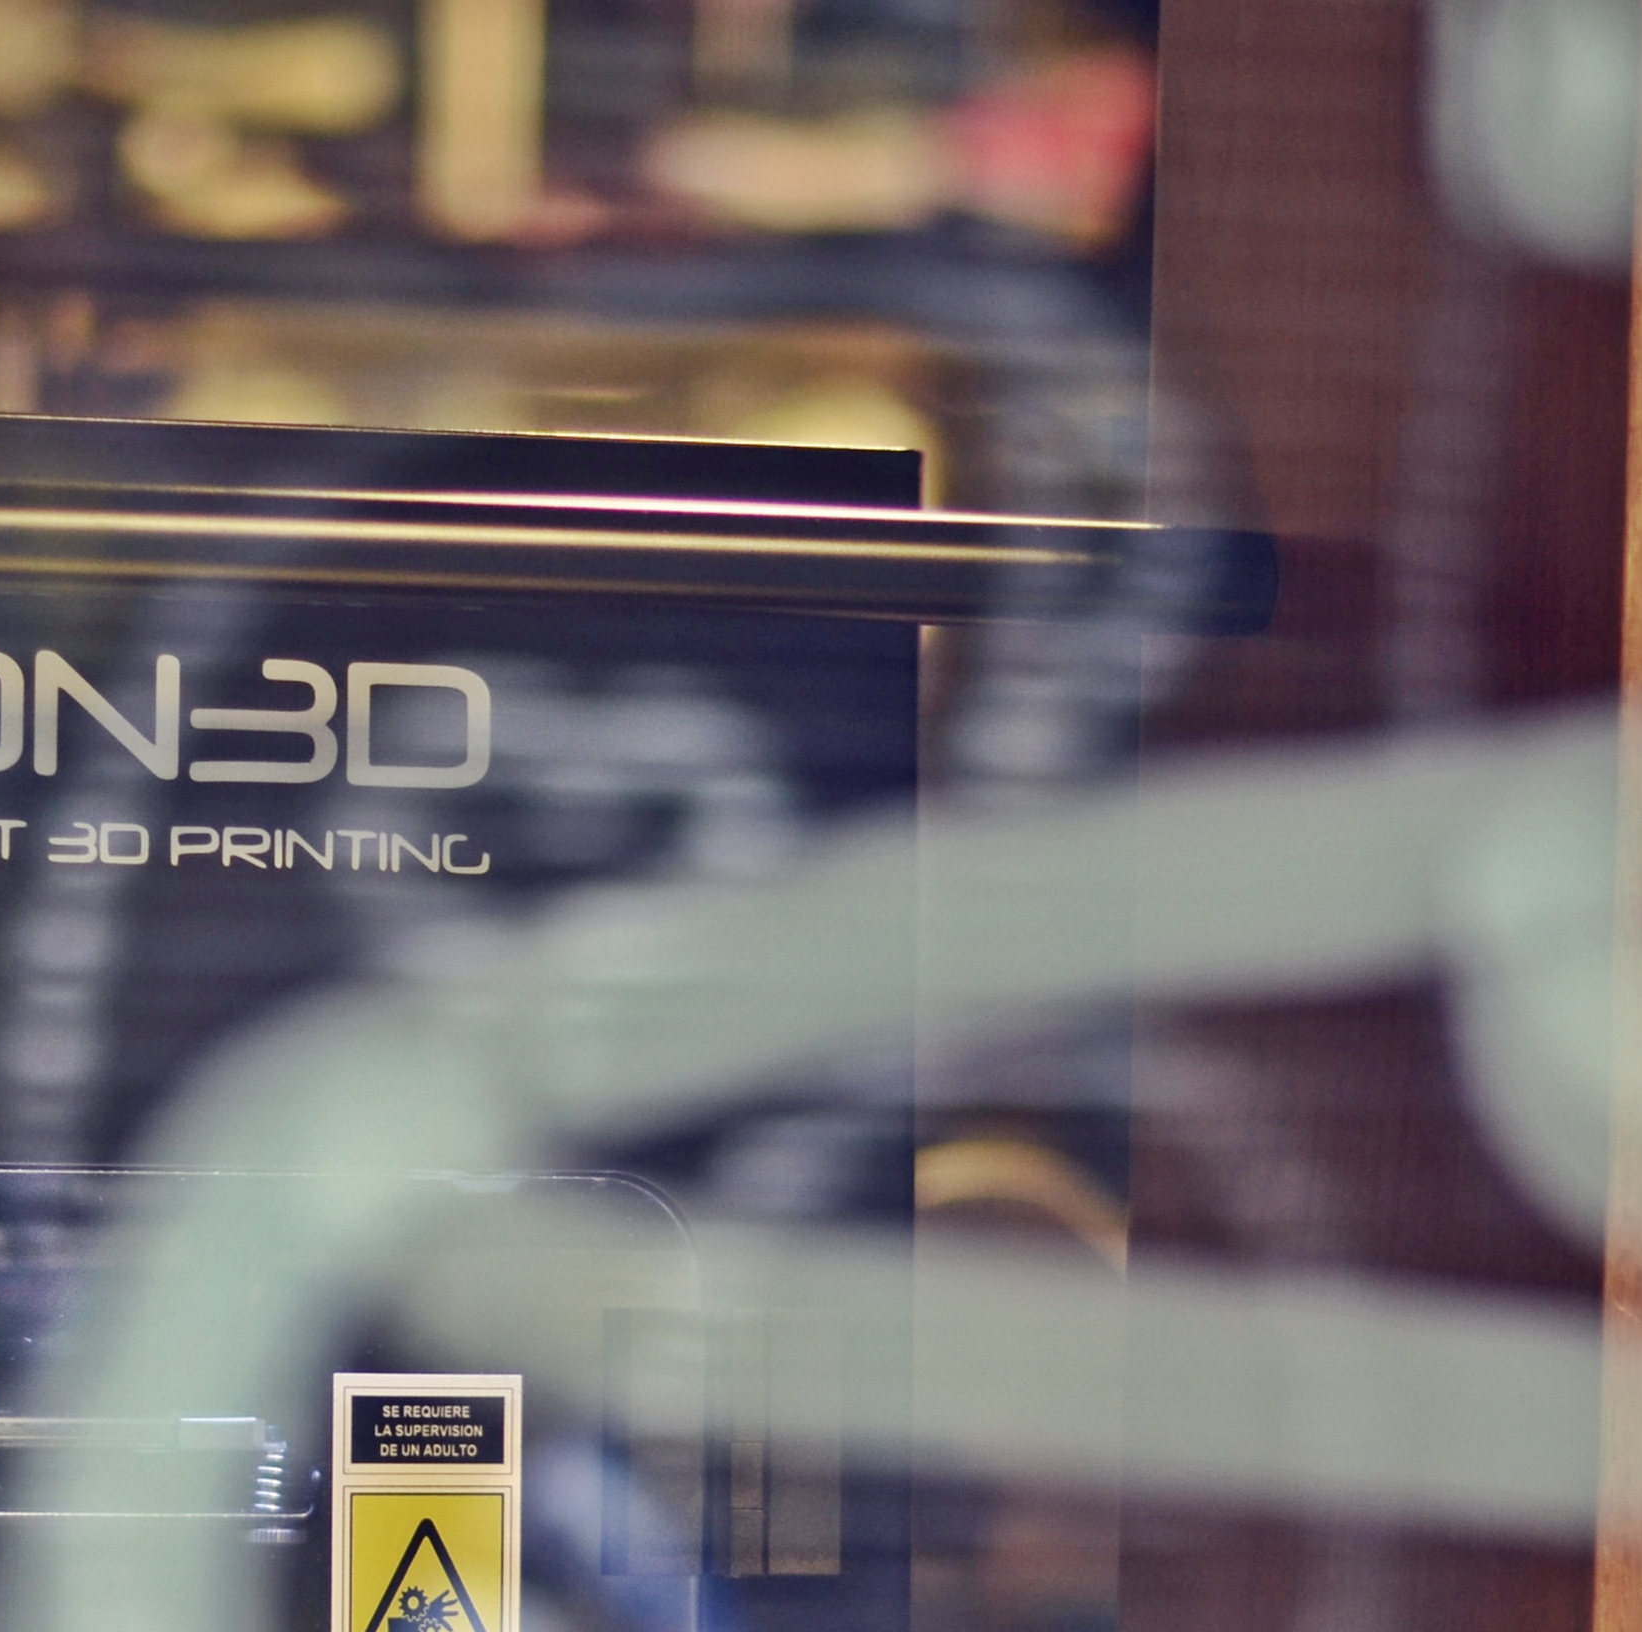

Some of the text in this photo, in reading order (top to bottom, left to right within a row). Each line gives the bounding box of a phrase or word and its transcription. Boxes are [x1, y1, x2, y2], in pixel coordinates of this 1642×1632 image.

[48, 822, 149, 865] 3D
[170, 826, 490, 874] PRINTING
[382, 1405, 470, 1418] SE REQUIERE
[374, 1424, 483, 1437] LA SUPERVISION
[380, 1443, 478, 1456] DE UN ADULTO
